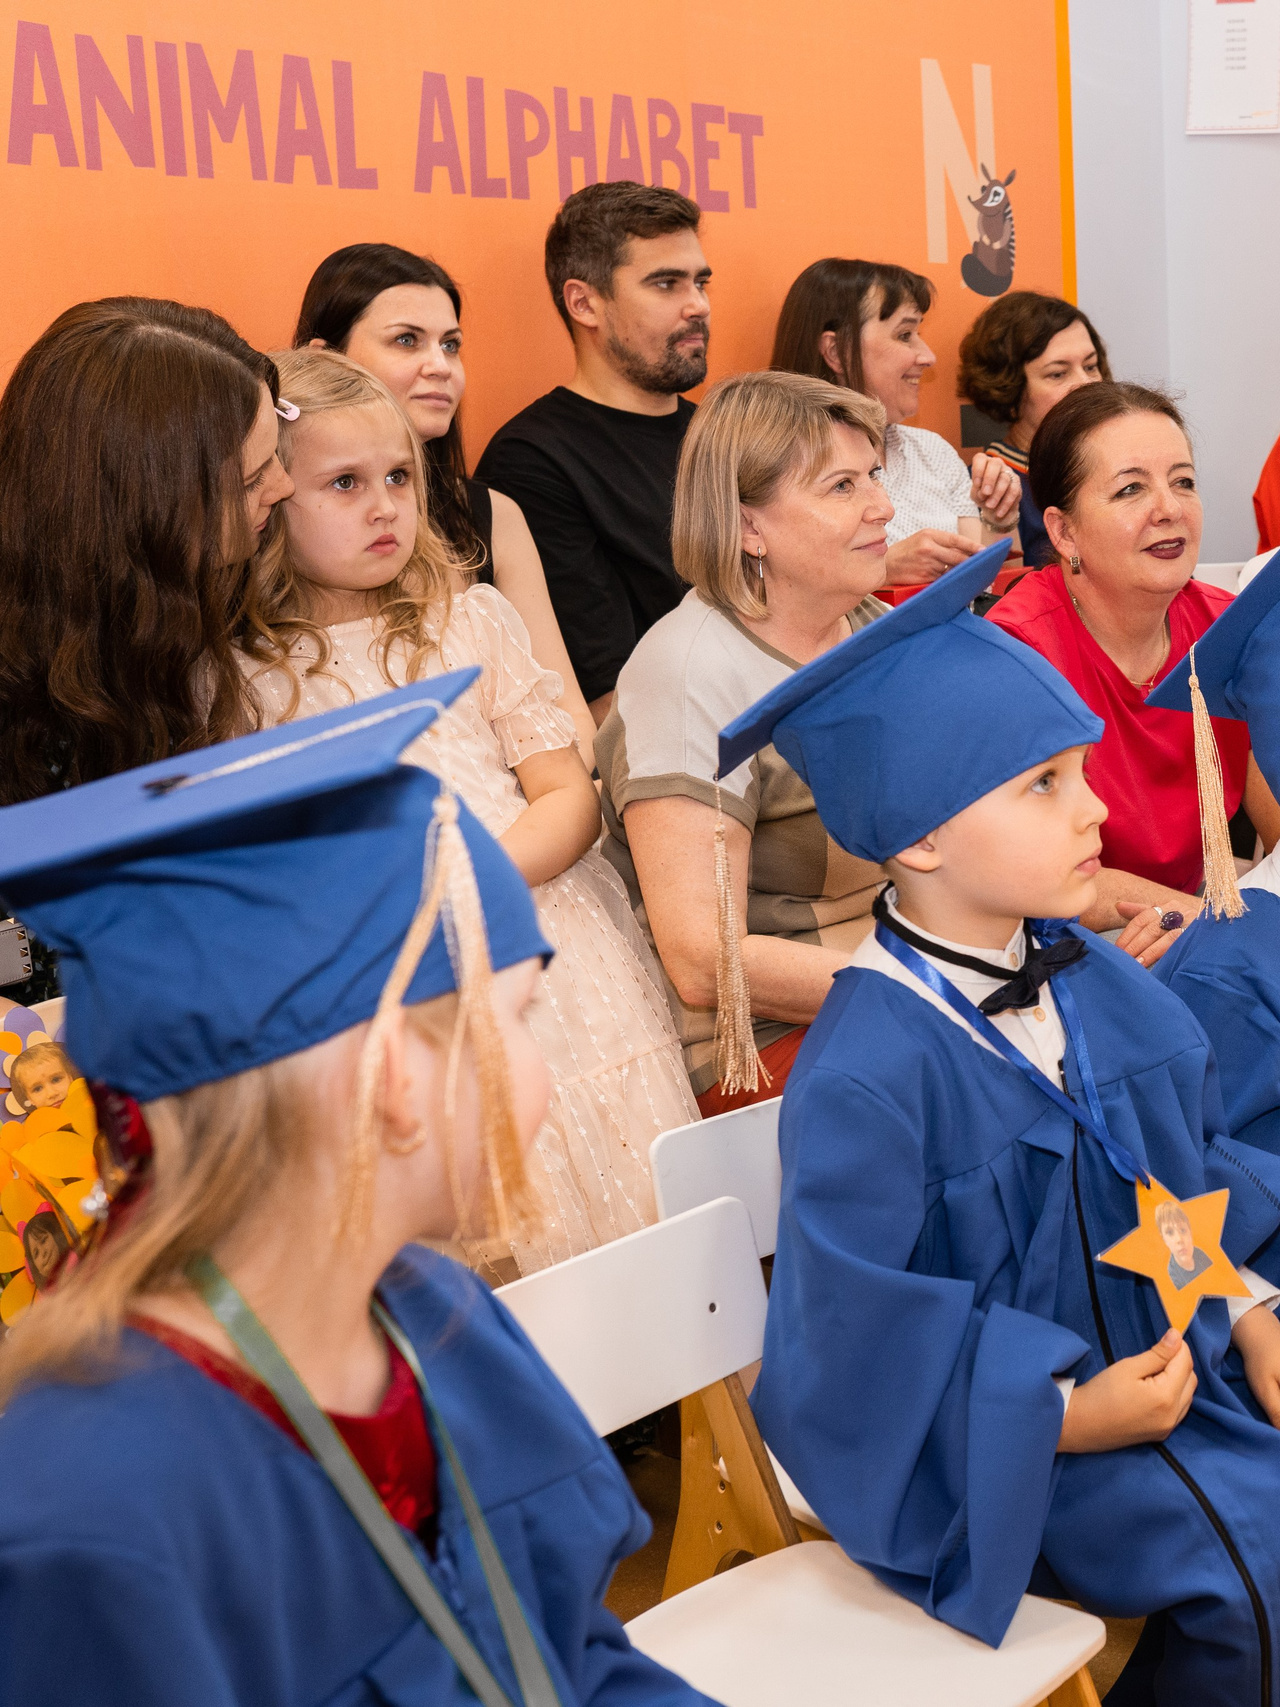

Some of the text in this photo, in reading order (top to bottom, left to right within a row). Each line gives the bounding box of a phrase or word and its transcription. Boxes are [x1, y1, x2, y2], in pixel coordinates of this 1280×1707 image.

[7, 20, 764, 213] ANIMAL ALPHABET
[920, 58, 997, 264] N
